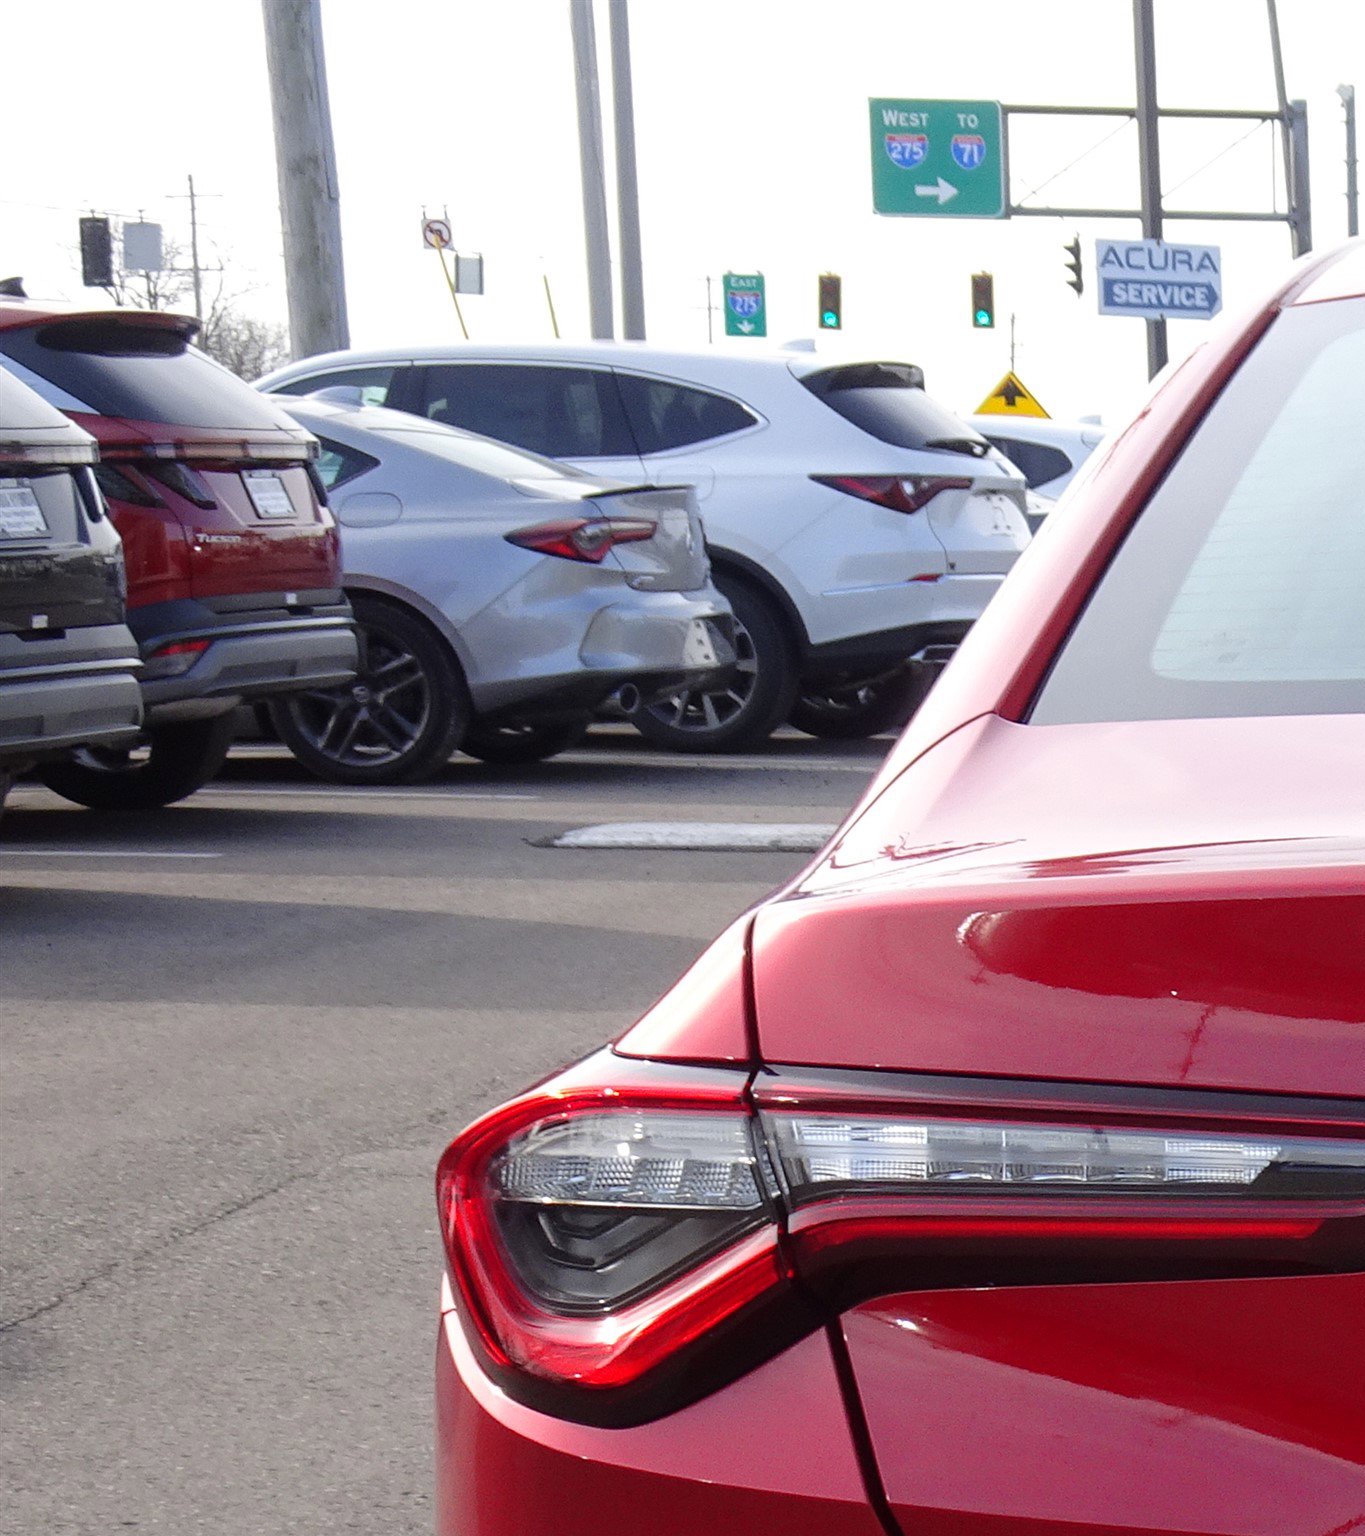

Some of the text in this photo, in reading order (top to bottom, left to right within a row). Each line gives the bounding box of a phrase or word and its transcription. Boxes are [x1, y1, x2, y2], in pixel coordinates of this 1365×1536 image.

[882, 109, 979, 129] WEST TO
[890, 141, 980, 163] 275 71
[1100, 245, 1219, 274] ACURA
[735, 296, 757, 313] 275
[1112, 282, 1210, 308] SERVICE
